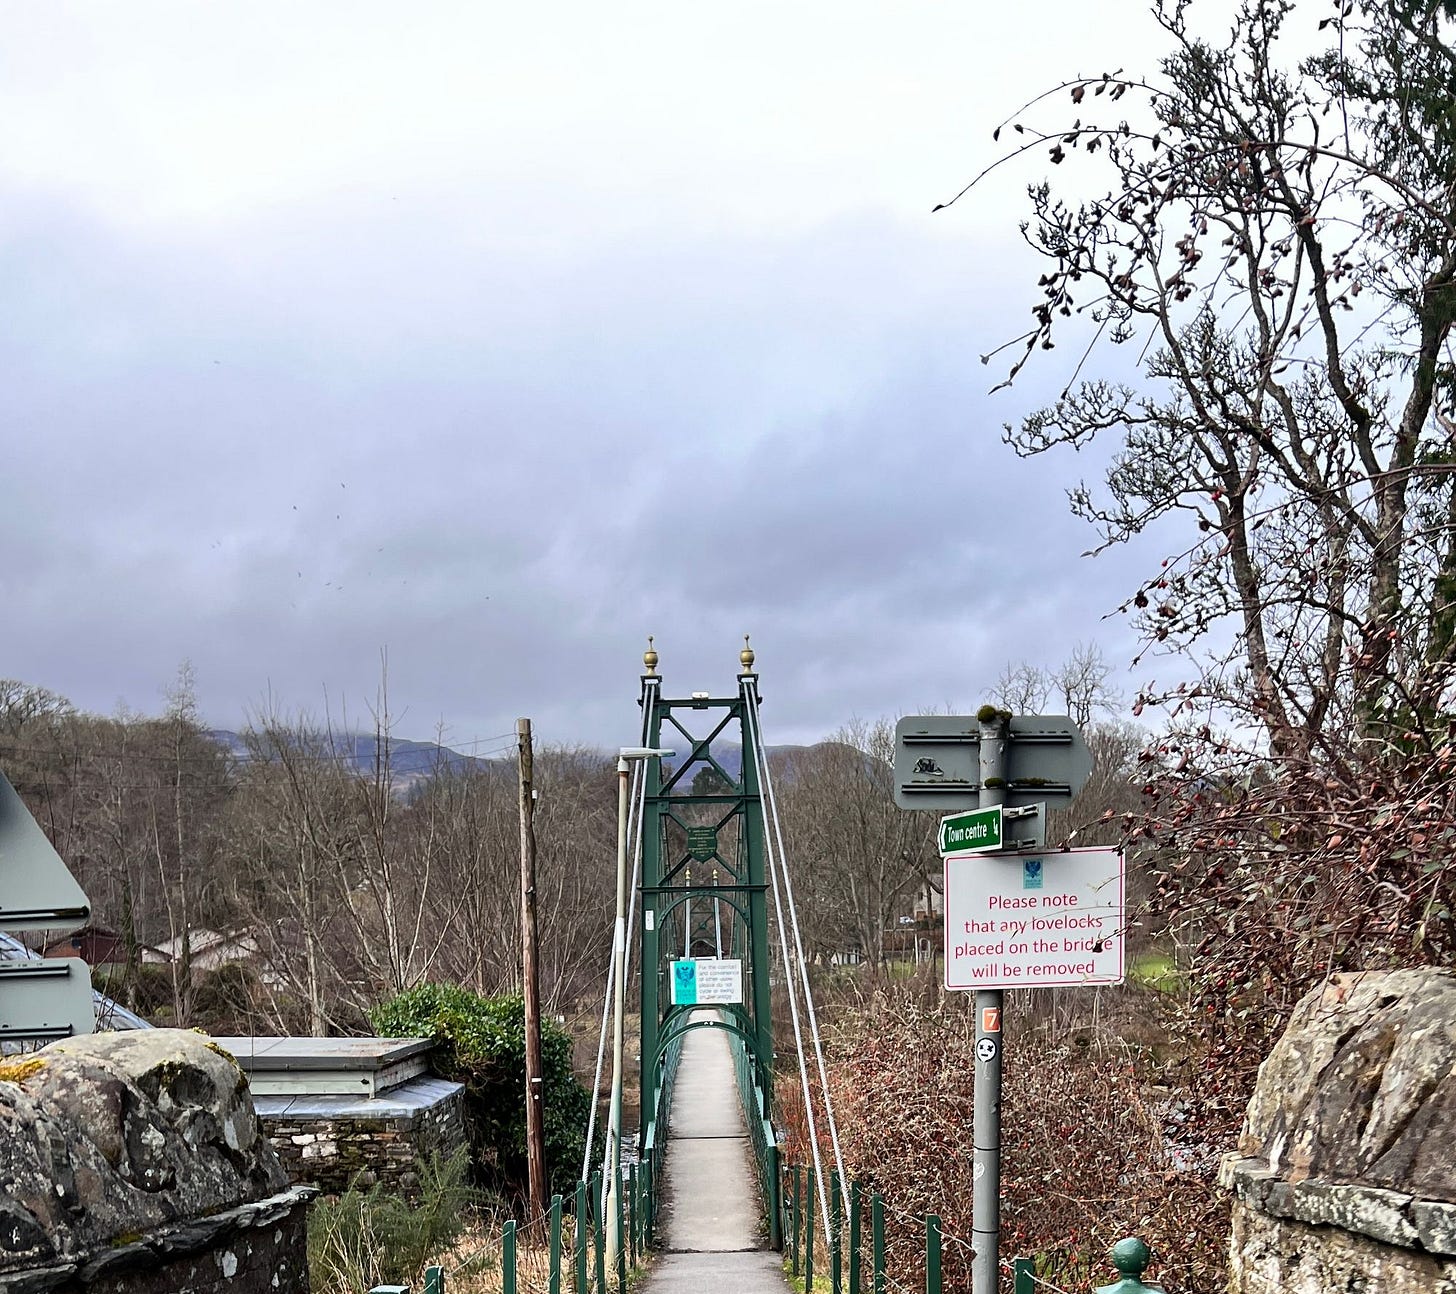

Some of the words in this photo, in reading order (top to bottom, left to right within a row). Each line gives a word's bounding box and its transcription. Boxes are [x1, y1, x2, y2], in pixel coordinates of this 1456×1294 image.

[948, 826, 964, 843] Town
[964, 821, 987, 840] centre
[989, 894, 1037, 909] Please
[1042, 893, 1078, 907] note
[964, 919, 995, 934] that
[1000, 921, 1027, 934] any
[1032, 914, 1103, 931] lovelocks
[955, 941, 1004, 959] placed
[1009, 943, 1028, 954] on
[1033, 940, 1058, 953] the
[1063, 937, 1113, 953] bride
[972, 963, 998, 978] will
[1003, 963, 1021, 977] be
[1026, 960, 1095, 976] removed
[986, 1012, 997, 1028] 7
